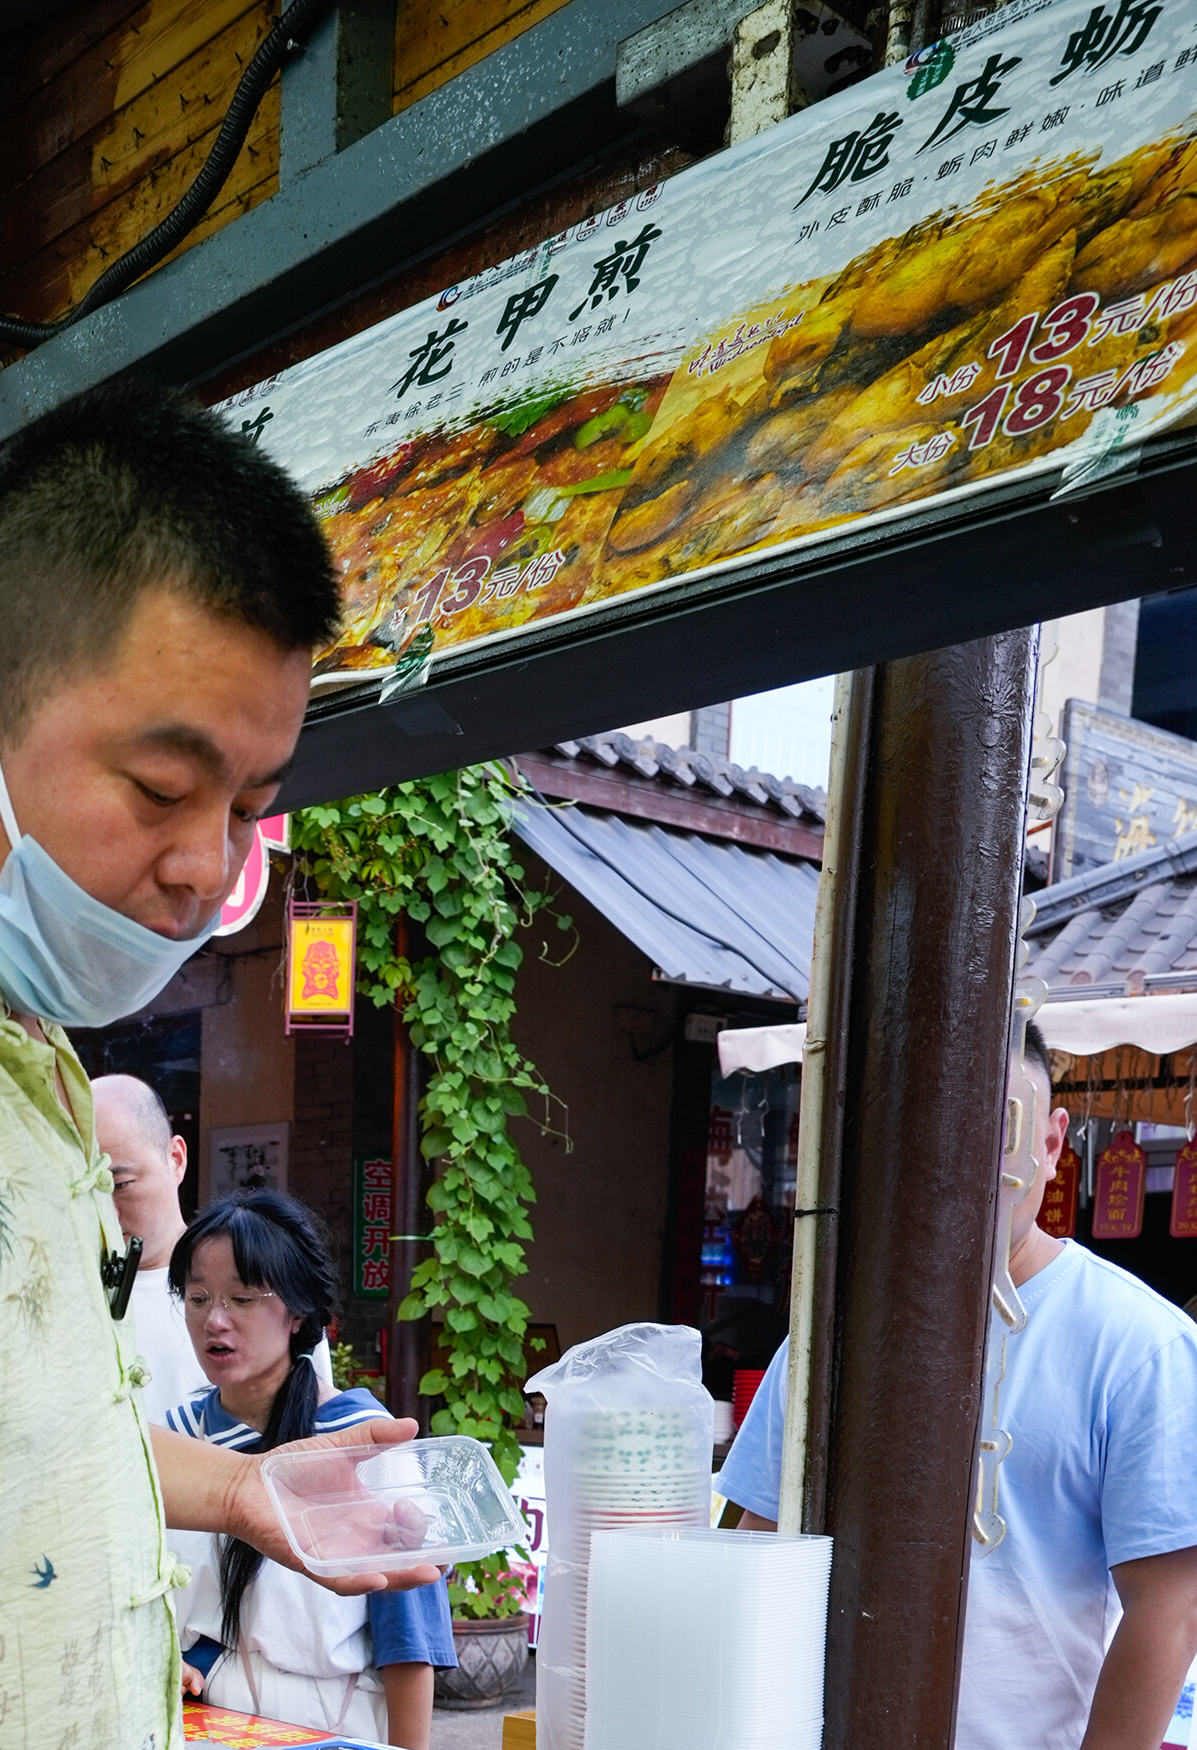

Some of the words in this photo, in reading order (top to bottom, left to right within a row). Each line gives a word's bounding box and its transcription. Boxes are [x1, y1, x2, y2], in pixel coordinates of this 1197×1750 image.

[387, 223, 663, 399] 花甲煎
[888, 430, 957, 477] 大份
[960, 340, 1186, 451] 18元/份
[916, 361, 984, 406] 小份
[363, 1159, 392, 1291] 空调开放
